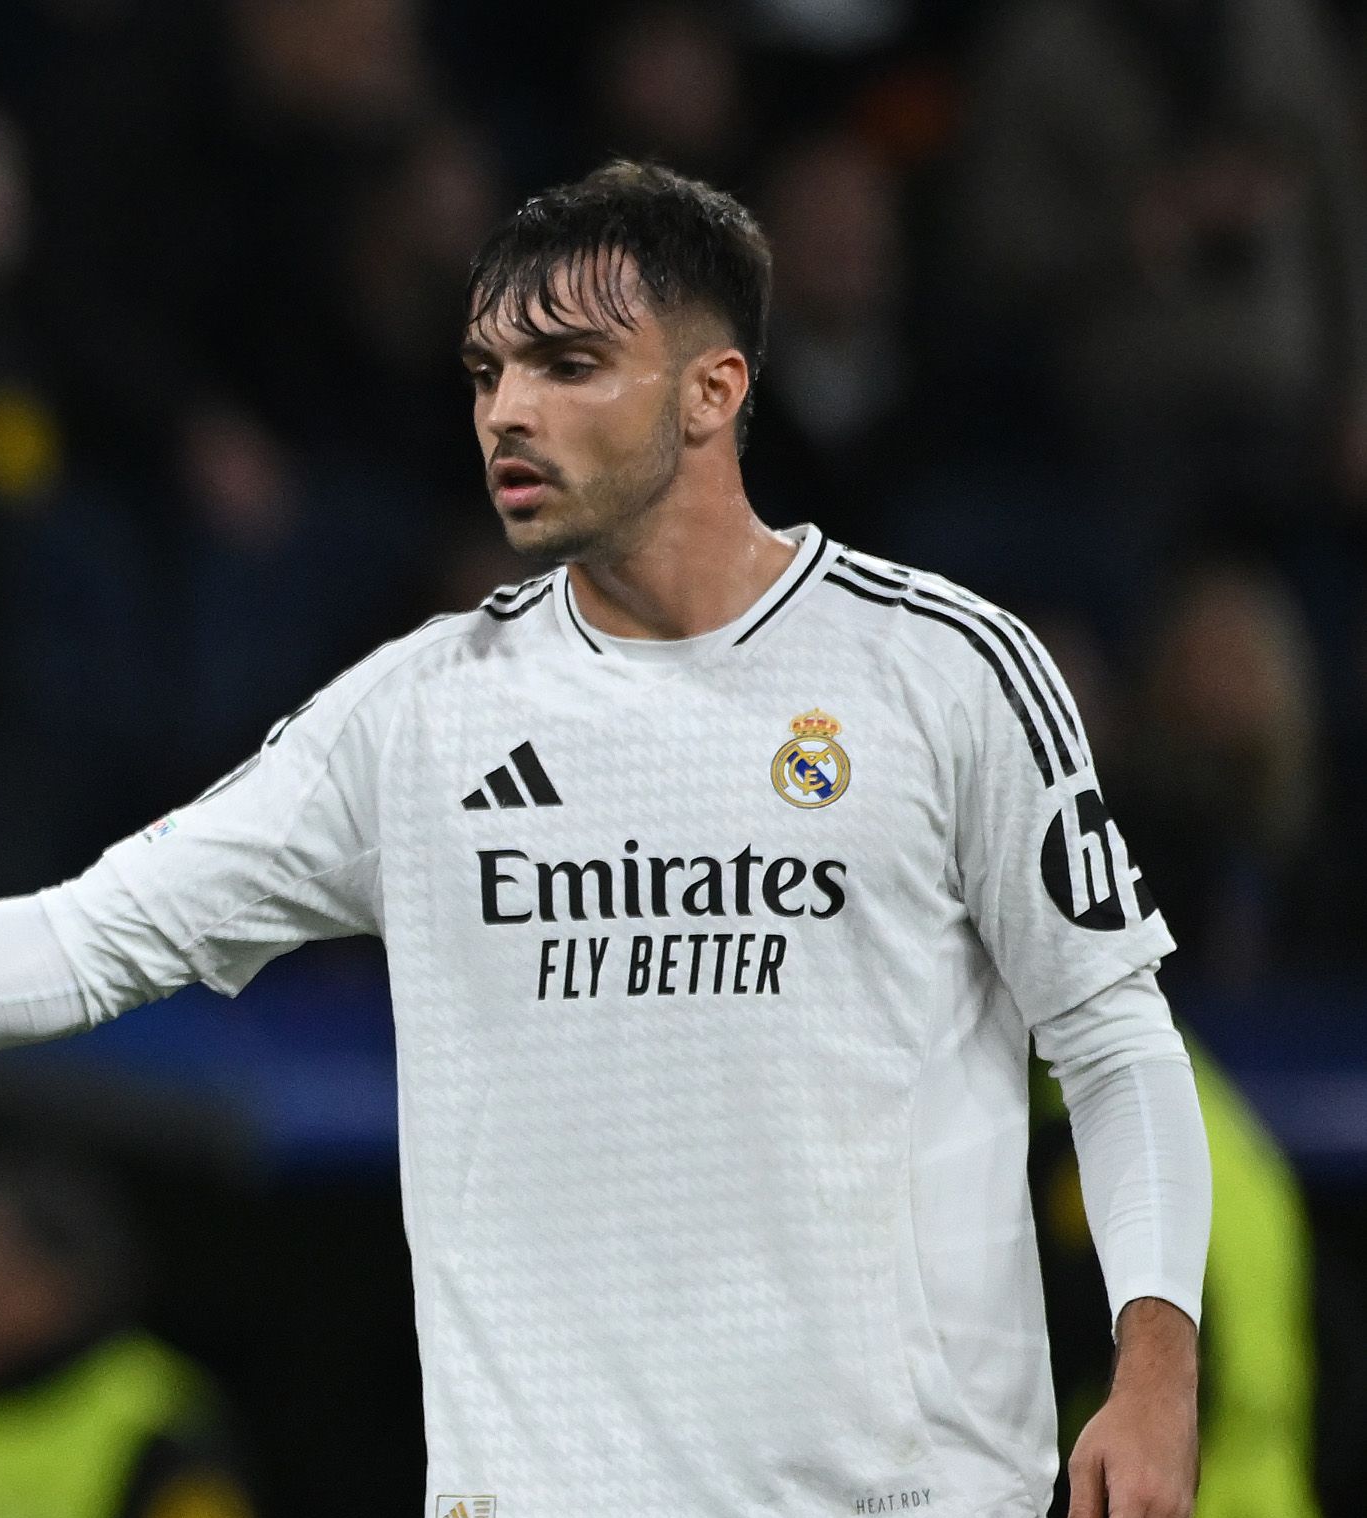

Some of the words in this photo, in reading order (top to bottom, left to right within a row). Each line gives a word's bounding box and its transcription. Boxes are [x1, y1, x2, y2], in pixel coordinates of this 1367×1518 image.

[474, 839, 848, 926] Emirates
[538, 936, 610, 1000] FLY
[627, 933, 787, 997] BETTER
